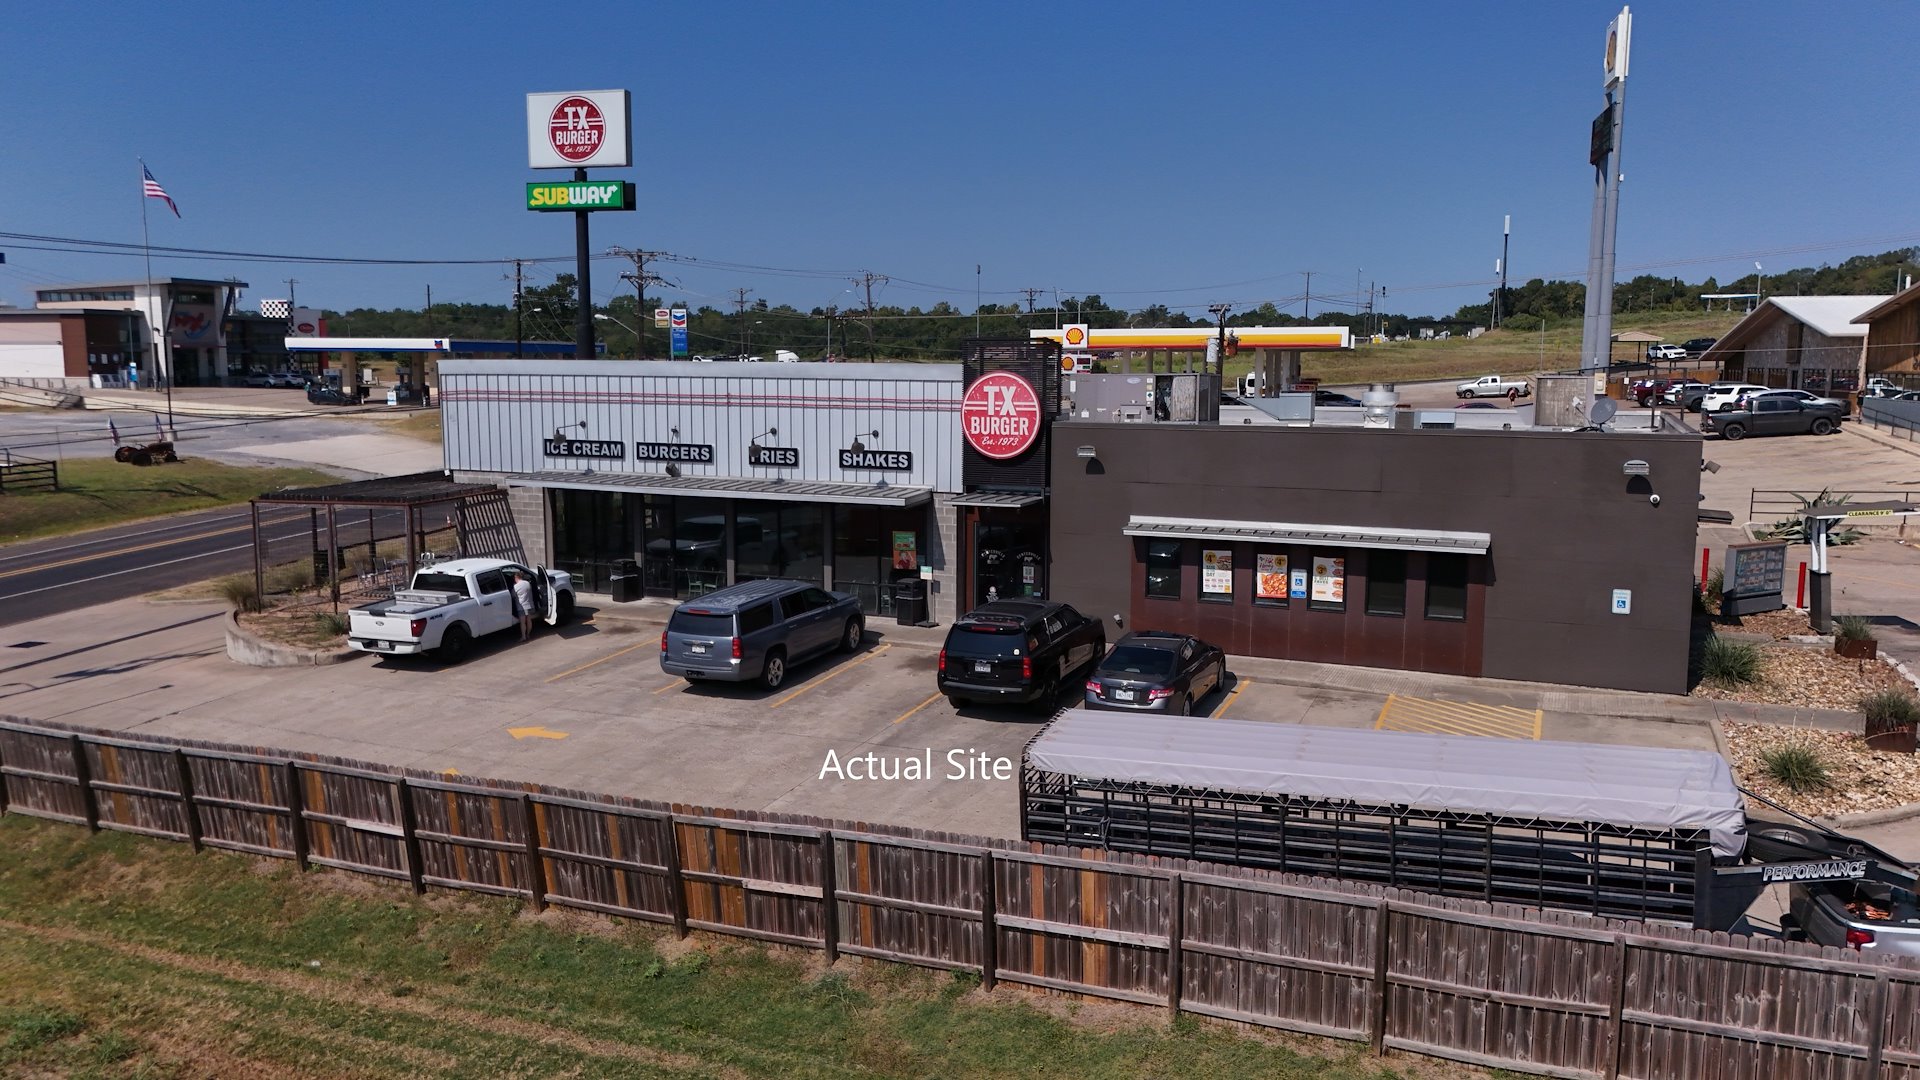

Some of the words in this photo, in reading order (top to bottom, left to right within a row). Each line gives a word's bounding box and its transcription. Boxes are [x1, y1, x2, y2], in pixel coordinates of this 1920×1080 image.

[564, 106, 590, 130] TX
[556, 130, 599, 145] BURGER
[575, 145, 591, 153] 1973
[530, 184, 618, 206] SUBWAY
[983, 386, 1017, 416] TX
[971, 416, 1029, 436] BURGER
[546, 442, 568, 454] ICE
[572, 442, 622, 456] CREAM
[998, 437, 1019, 446] 1973
[638, 445, 710, 461] BURGERS
[842, 452, 909, 468] SHAKES
[1763, 861, 1866, 881] PERFORMANCE
